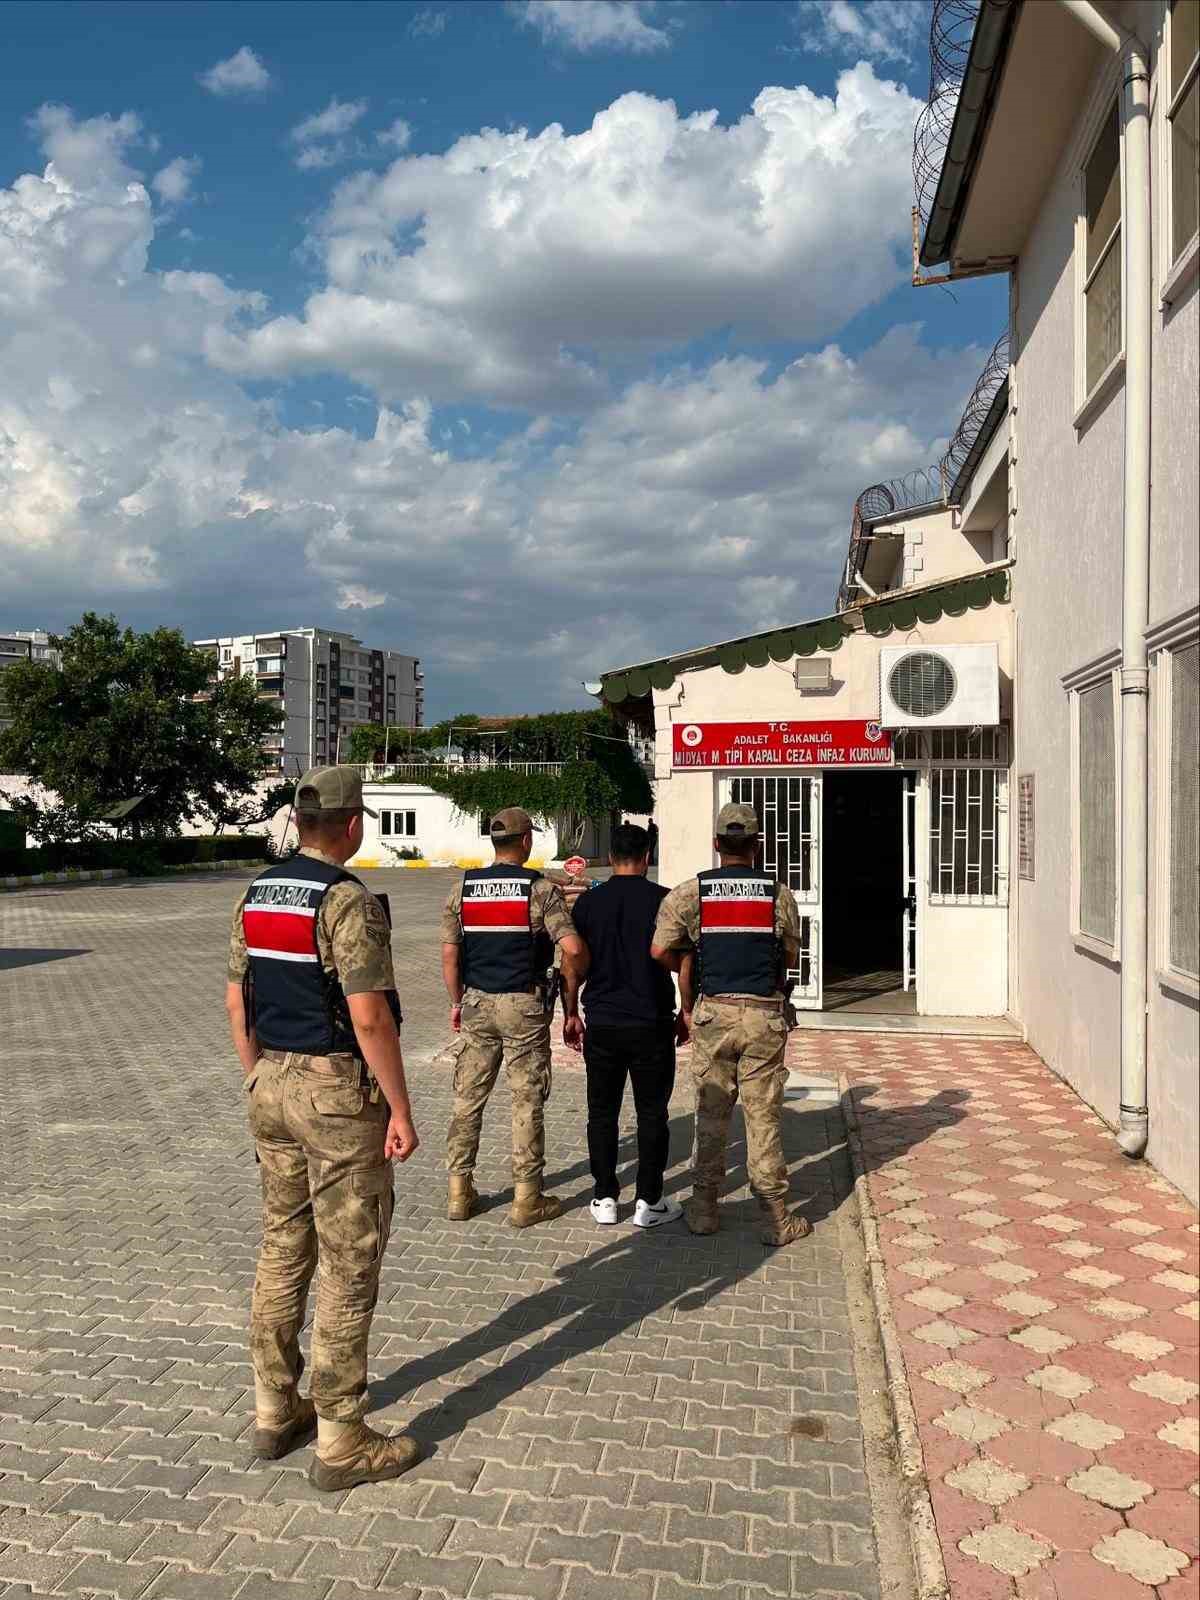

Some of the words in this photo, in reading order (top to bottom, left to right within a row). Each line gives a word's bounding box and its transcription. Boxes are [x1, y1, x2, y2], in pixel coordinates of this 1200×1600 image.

[768, 722, 791, 732] T.C.
[734, 735, 769, 745] ADALET
[783, 731, 832, 744] BAKANLIĞI
[711, 750, 720, 764] M
[724, 747, 743, 764] TİPİ
[747, 748, 782, 763] KAPALI
[786, 749, 812, 762] CEZA
[817, 745, 845, 761] İNFAZ
[849, 747, 891, 761] KURUMU
[470, 884, 522, 897] JANDARMA
[708, 882, 766, 896] JANDARMA
[251, 885, 312, 908] JANDARMA
